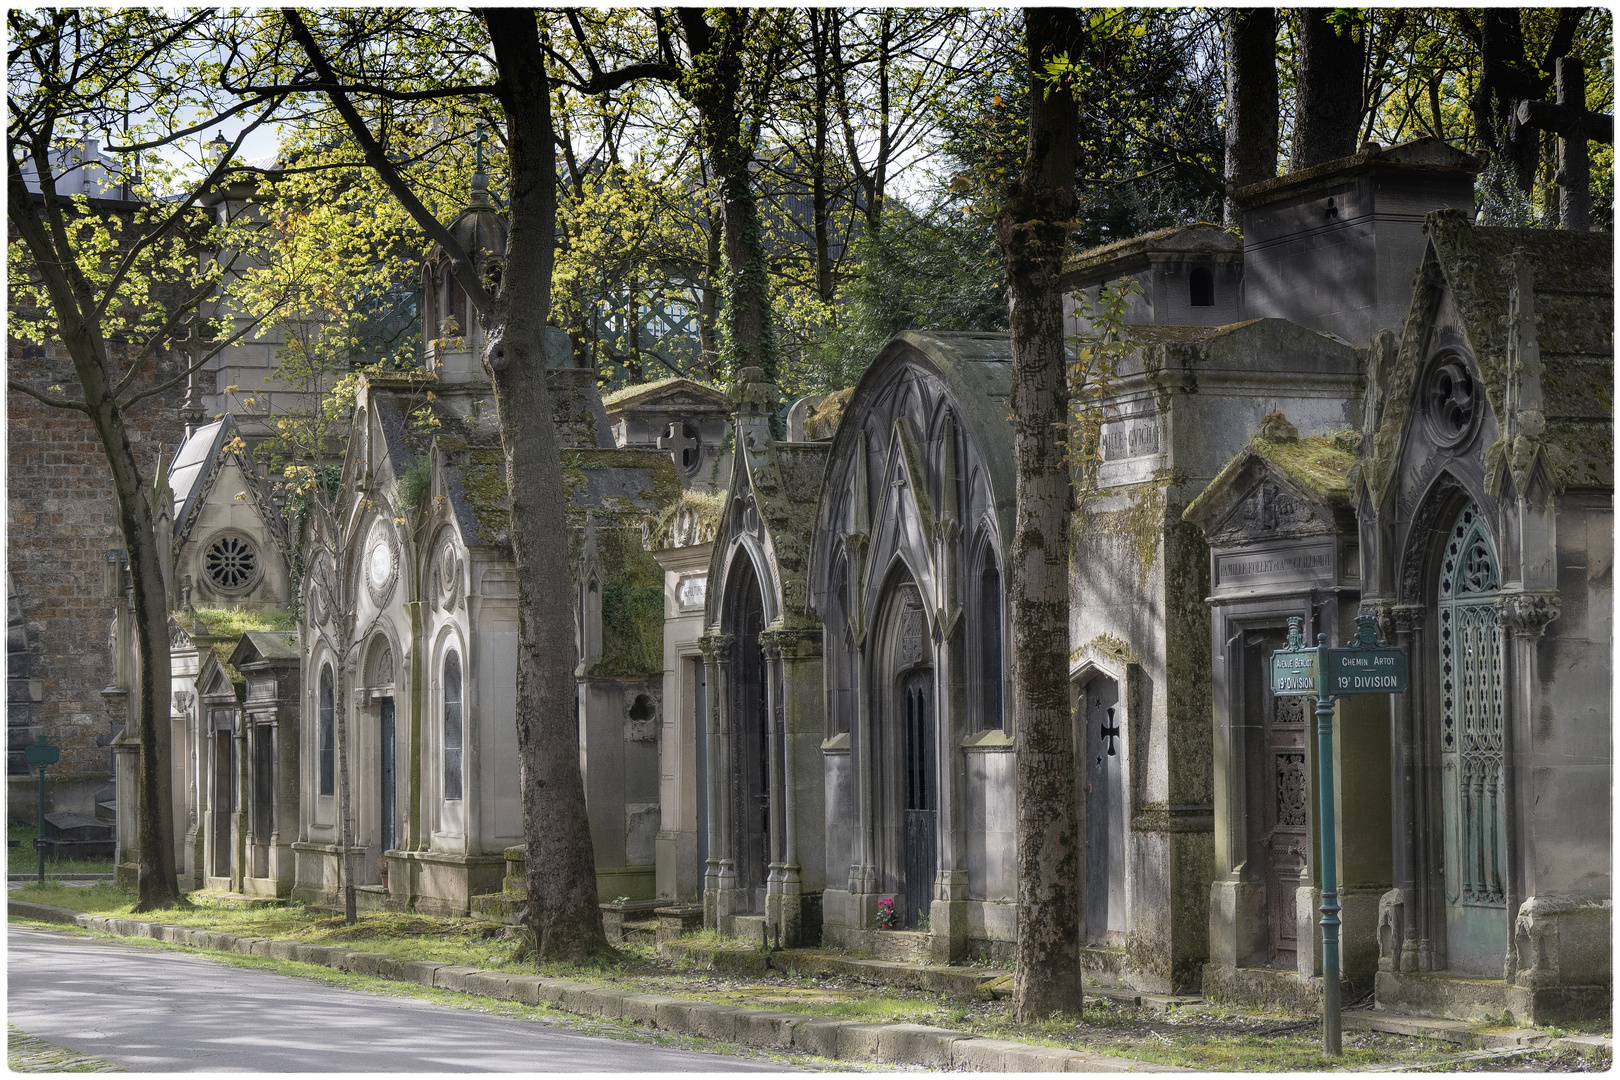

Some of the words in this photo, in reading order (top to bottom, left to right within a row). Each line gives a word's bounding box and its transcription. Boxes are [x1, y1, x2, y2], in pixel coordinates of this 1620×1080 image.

[1220, 562, 1247, 577] FAMILLE
[1287, 677, 1314, 689] DIVISION
[1354, 675, 1397, 688] DIVISION
